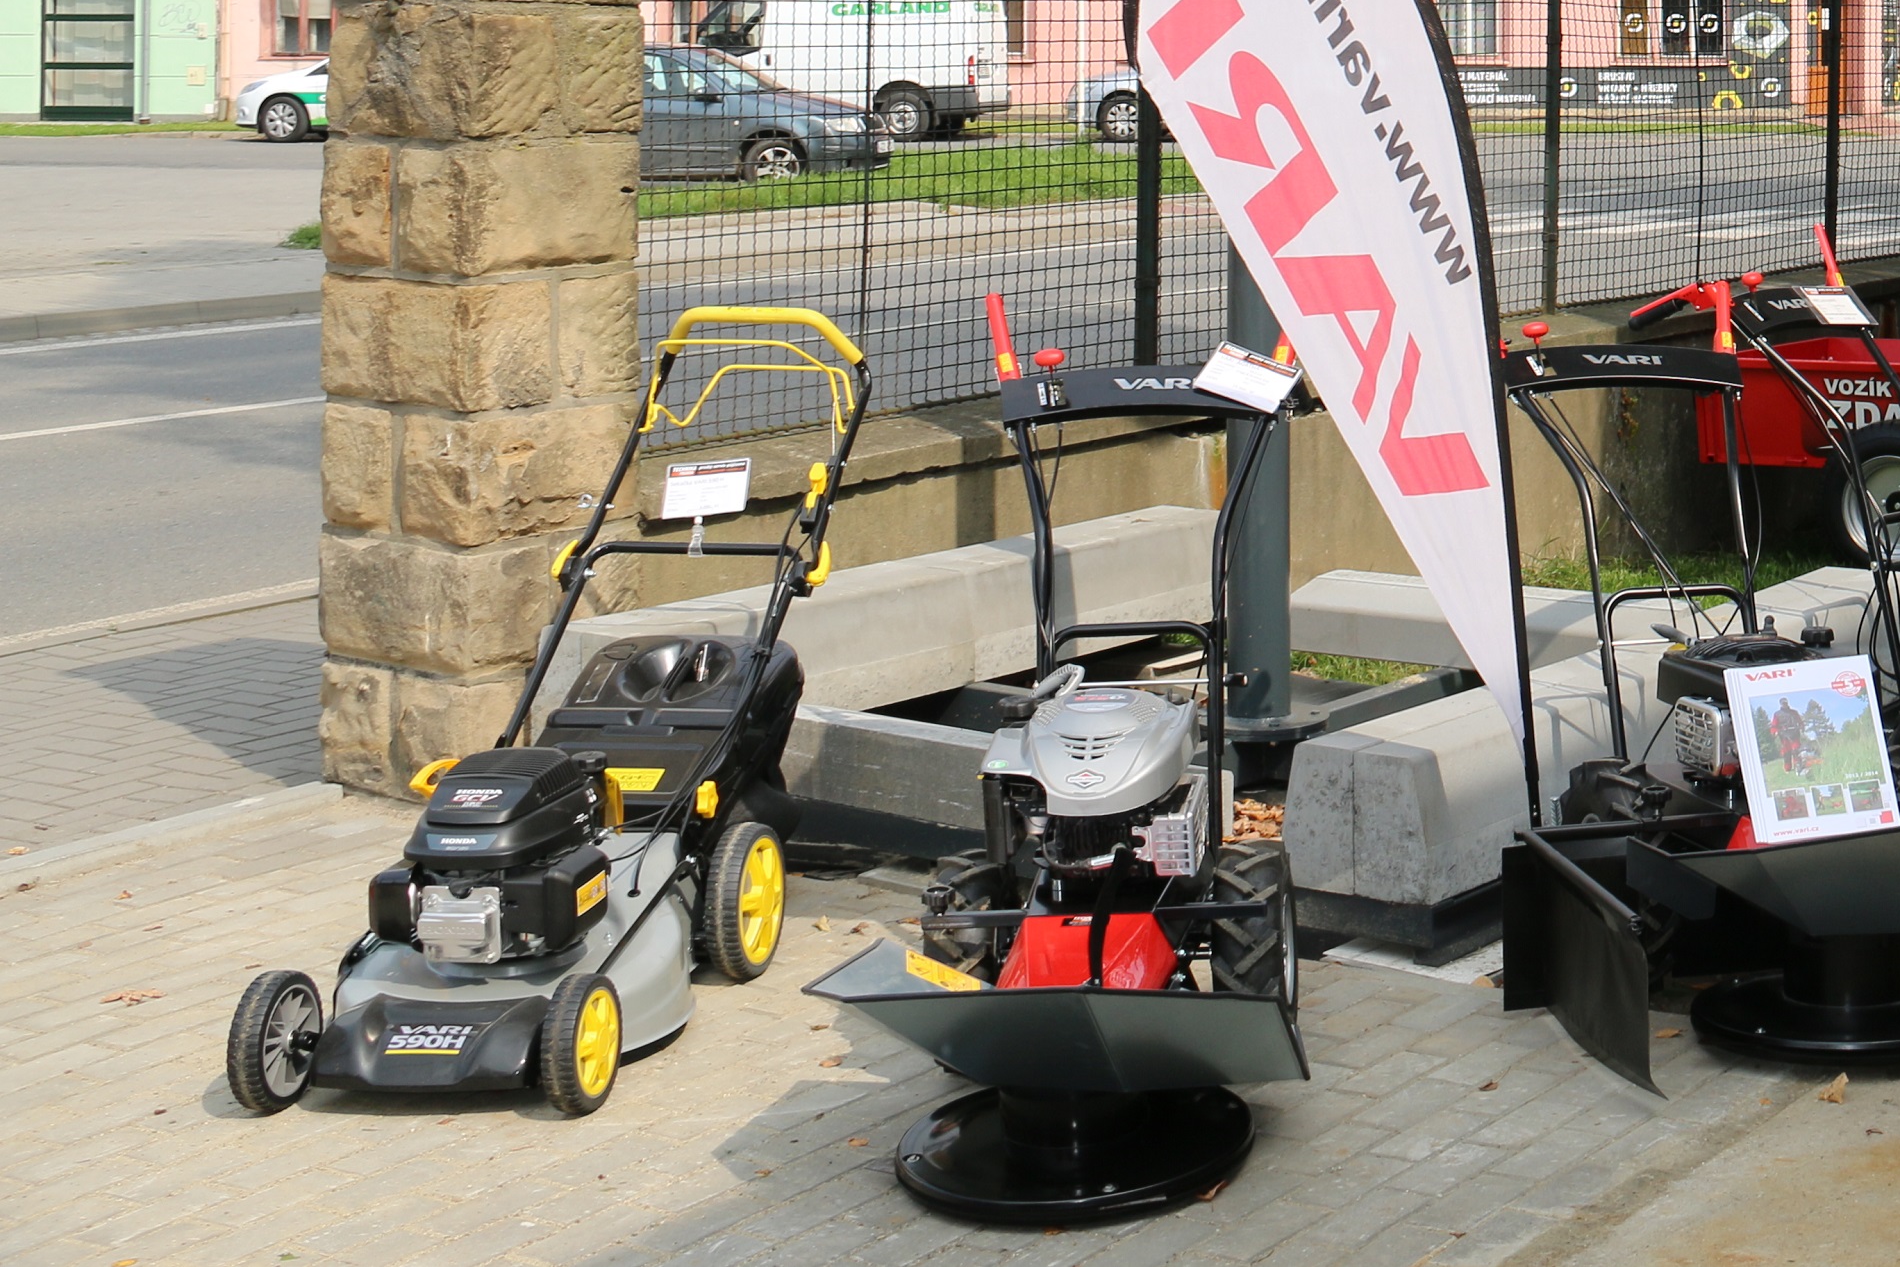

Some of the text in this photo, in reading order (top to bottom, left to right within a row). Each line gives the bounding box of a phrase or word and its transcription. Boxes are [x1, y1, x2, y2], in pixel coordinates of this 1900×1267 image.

[832, 1, 950, 16] GARLAND
[1768, 298, 1809, 311] VAR
[1582, 354, 1663, 365] VARI
[1113, 377, 1197, 390] VAR
[1823, 377, 1892, 398] VOZÍK
[1745, 669, 1793, 682] VARI
[455, 788, 504, 796] HONDA
[452, 794, 499, 803] GCV
[1773, 826, 1820, 837] www.vari.cz
[440, 837, 478, 845] HONDA
[400, 1025, 474, 1035] VARI
[387, 1035, 467, 1049] 590H
